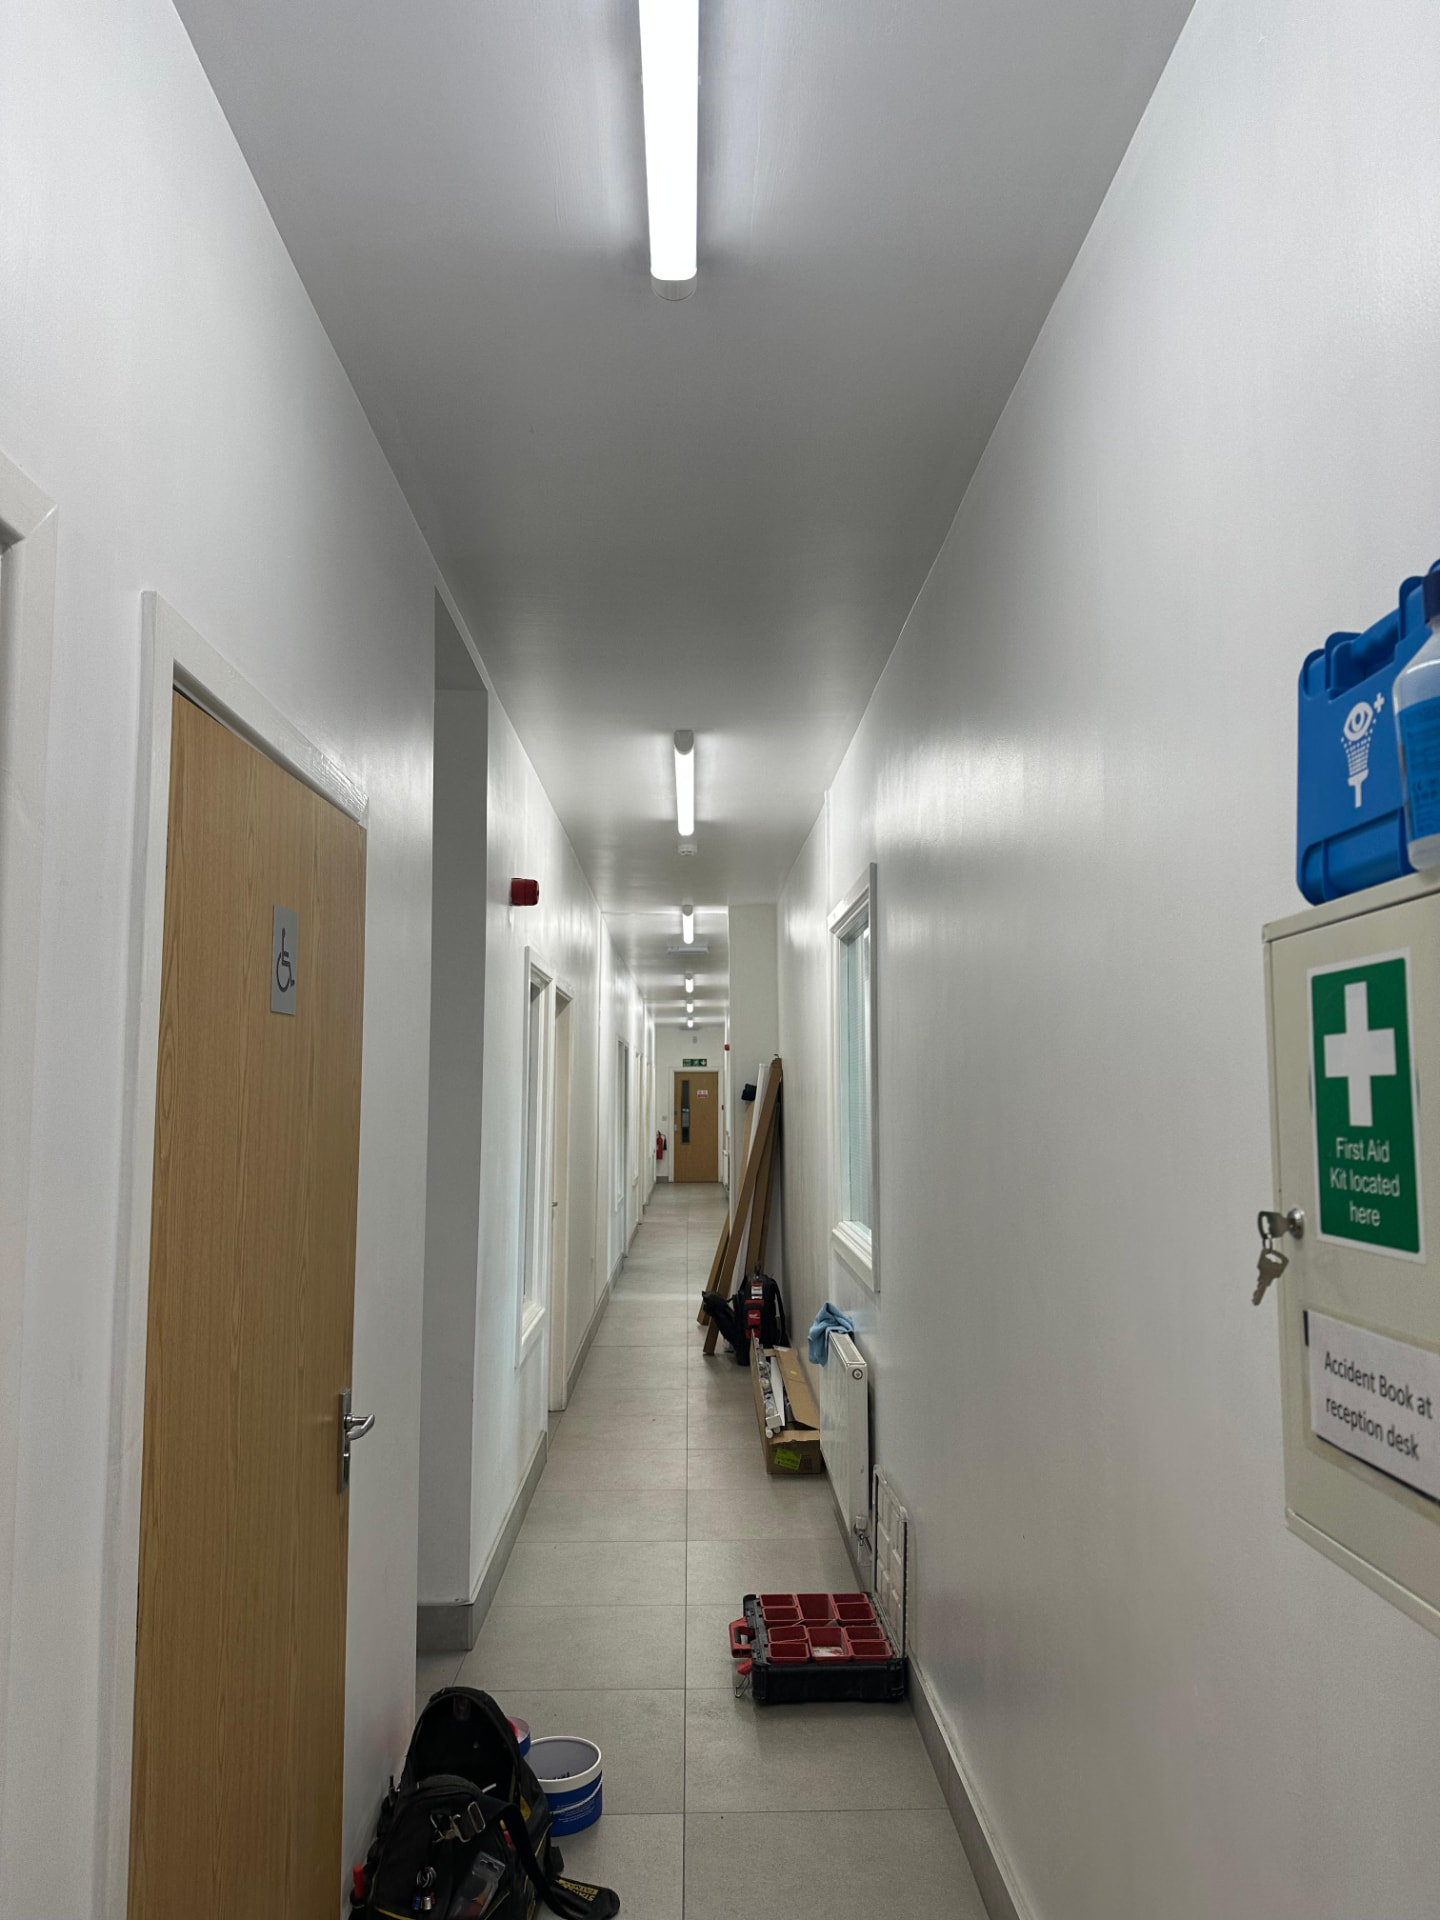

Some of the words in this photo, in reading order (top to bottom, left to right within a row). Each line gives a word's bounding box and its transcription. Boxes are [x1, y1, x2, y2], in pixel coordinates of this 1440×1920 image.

[1336, 1137, 1364, 1161] First
[1366, 1139, 1390, 1163] Aid
[1329, 1166, 1347, 1190] Kit
[1349, 1168, 1400, 1197] located
[1349, 1200, 1380, 1227] here
[1324, 1351, 1376, 1393] Accident
[1379, 1375, 1414, 1411] Book
[1417, 1397, 1433, 1420] at
[1326, 1397, 1384, 1443] reception
[1387, 1424, 1420, 1461] desk
